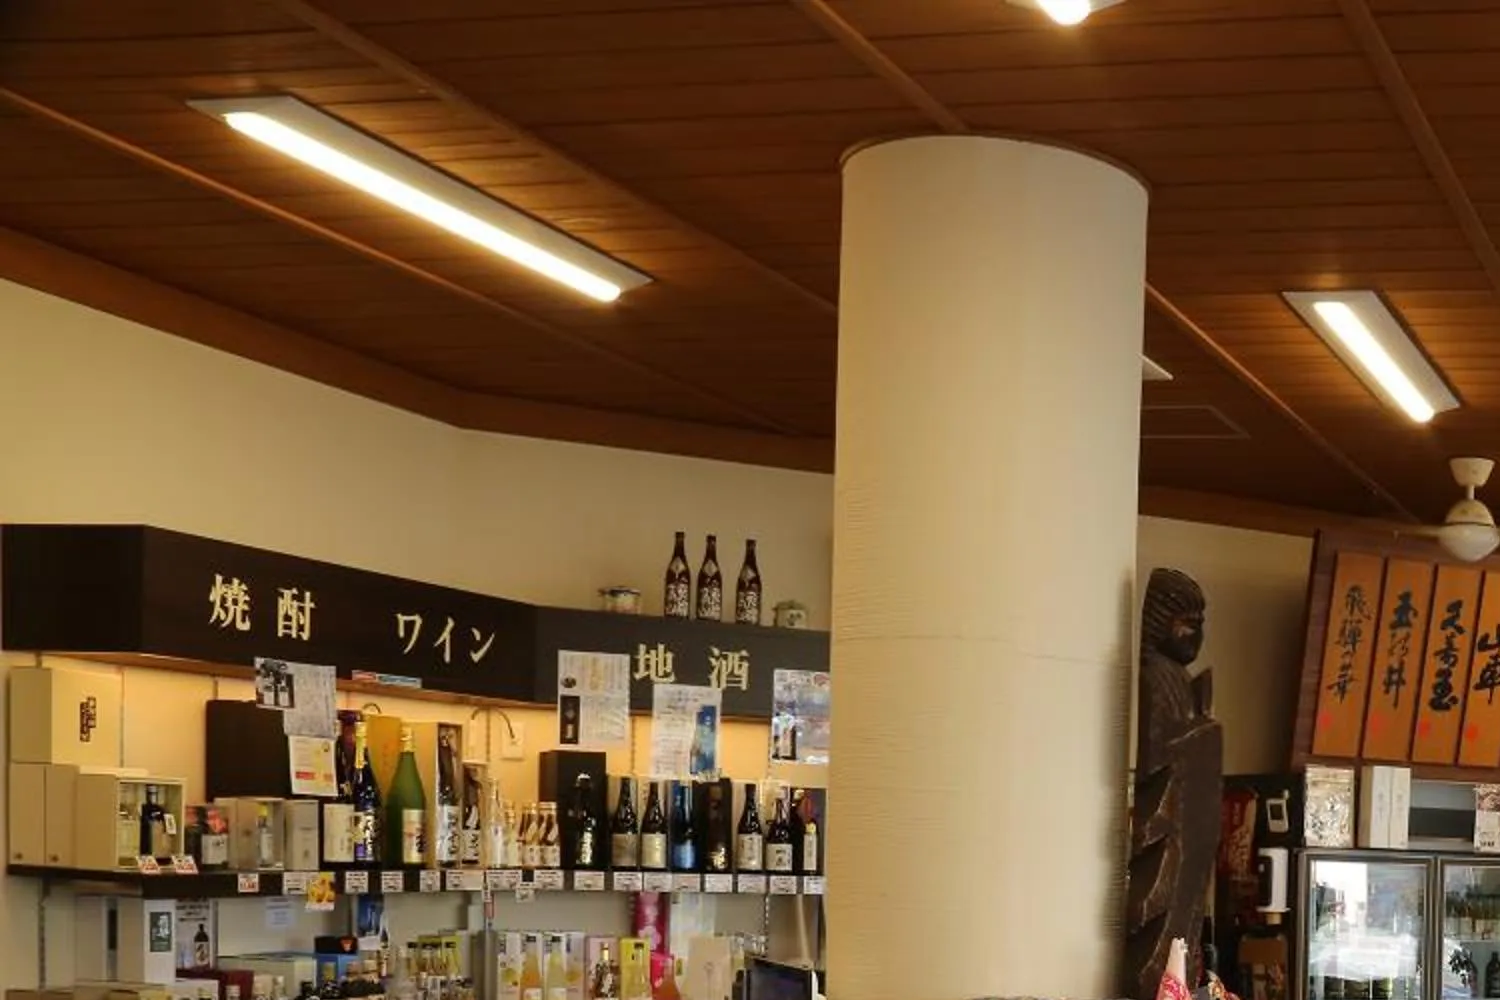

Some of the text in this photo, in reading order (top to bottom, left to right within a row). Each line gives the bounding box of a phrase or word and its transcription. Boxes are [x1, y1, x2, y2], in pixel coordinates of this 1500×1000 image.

[209, 573, 316, 641] 焼酎
[395, 612, 495, 664] ワイン
[634, 643, 749, 691] 地酒
